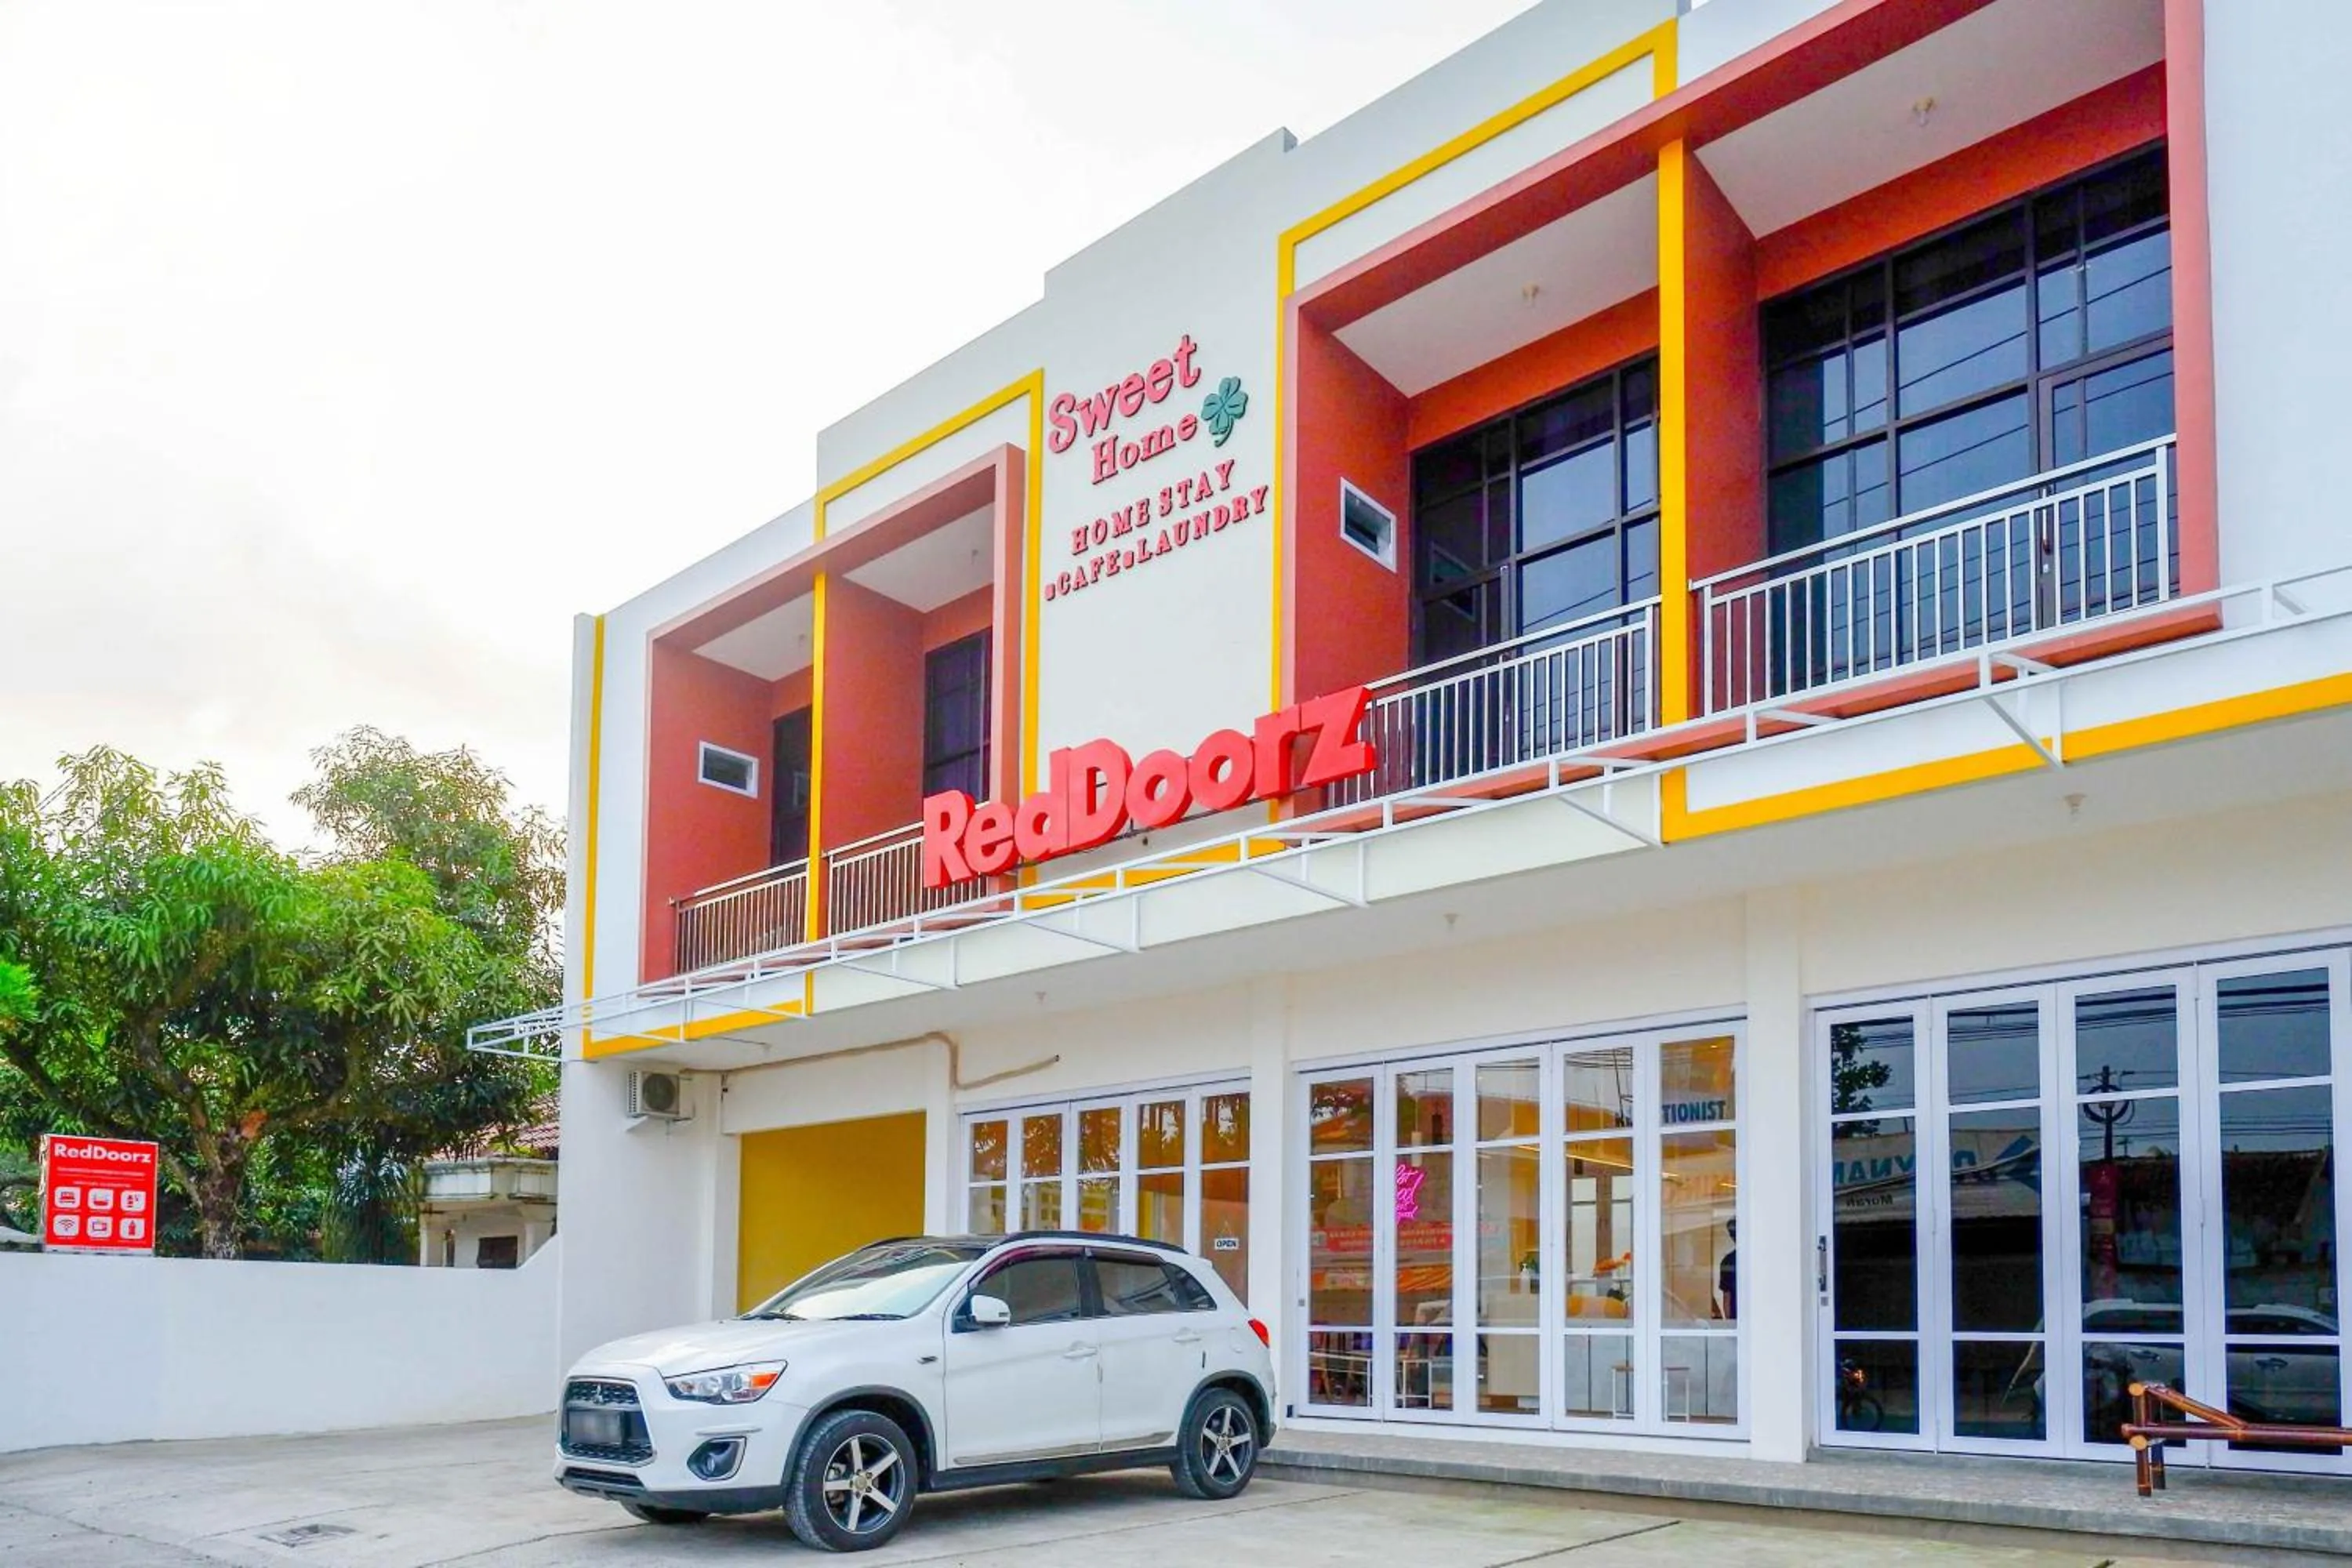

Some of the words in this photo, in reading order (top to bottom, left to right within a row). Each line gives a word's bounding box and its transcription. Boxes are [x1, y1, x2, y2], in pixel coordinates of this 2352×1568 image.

[1048, 334, 1201, 453] Sweet
[1091, 413, 1198, 485] Home
[1071, 498, 1150, 555] HOME
[1158, 459, 1236, 517] STAY
[924, 684, 1377, 890] RedDoorz
[54, 1142, 151, 1163] RedDoorz
